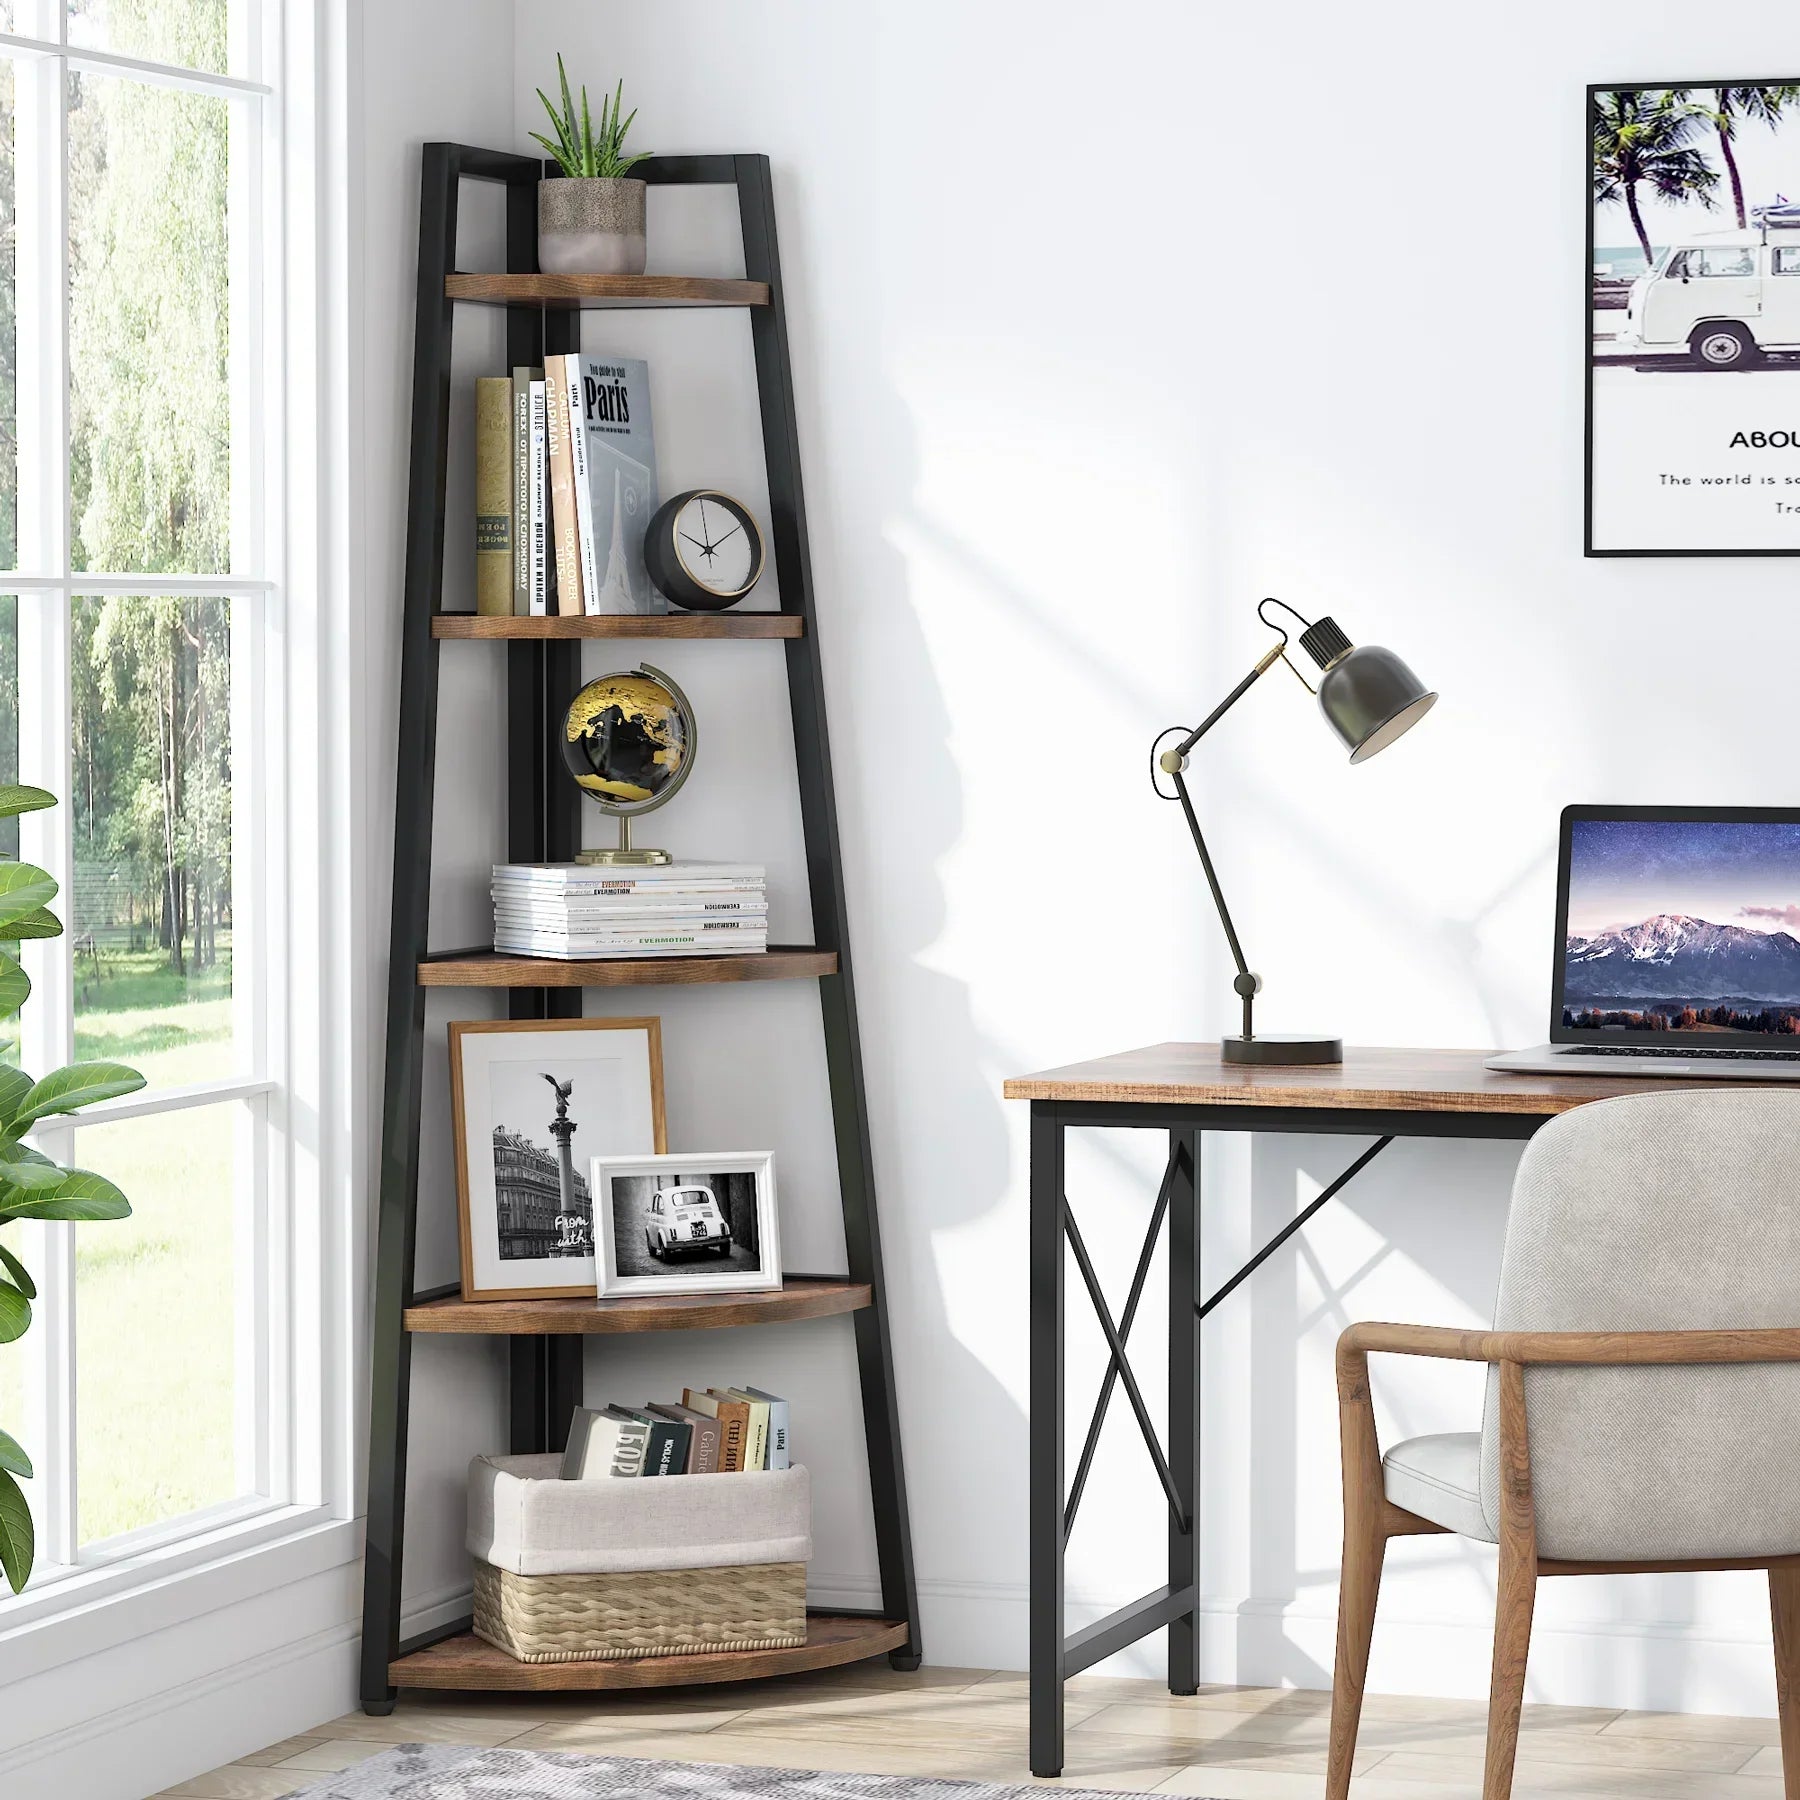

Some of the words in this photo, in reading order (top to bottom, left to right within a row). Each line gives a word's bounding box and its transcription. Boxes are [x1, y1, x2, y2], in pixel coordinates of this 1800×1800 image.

[571, 383, 579, 407] Paris
[583, 376, 630, 423] Paris
[545, 376, 559, 456] CHAPMAN
[559, 391, 570, 440] CALLUM
[520, 439, 527, 453] ОТ
[520, 456, 528, 511] ПРОСТОГО
[1659, 473, 1692, 486] The
[1700, 473, 1752, 486] world
[1760, 476, 1776, 486] is
[520, 514, 528, 522] К
[535, 522, 544, 554] ОСЕВОЙ
[564, 527, 576, 559] BOOK
[520, 524, 528, 590] СЛОЖНОМУ
[536, 557, 544, 568] НА
[536, 571, 544, 603] ПРЯТКИ
[566, 559, 578, 601] COVER
[601, 880, 636, 888] EVERMOTION
[639, 936, 695, 944] EVERMOTION
[554, 1215, 589, 1231] From
[557, 1229, 588, 1247] with
[776, 1428, 785, 1450] Paris
